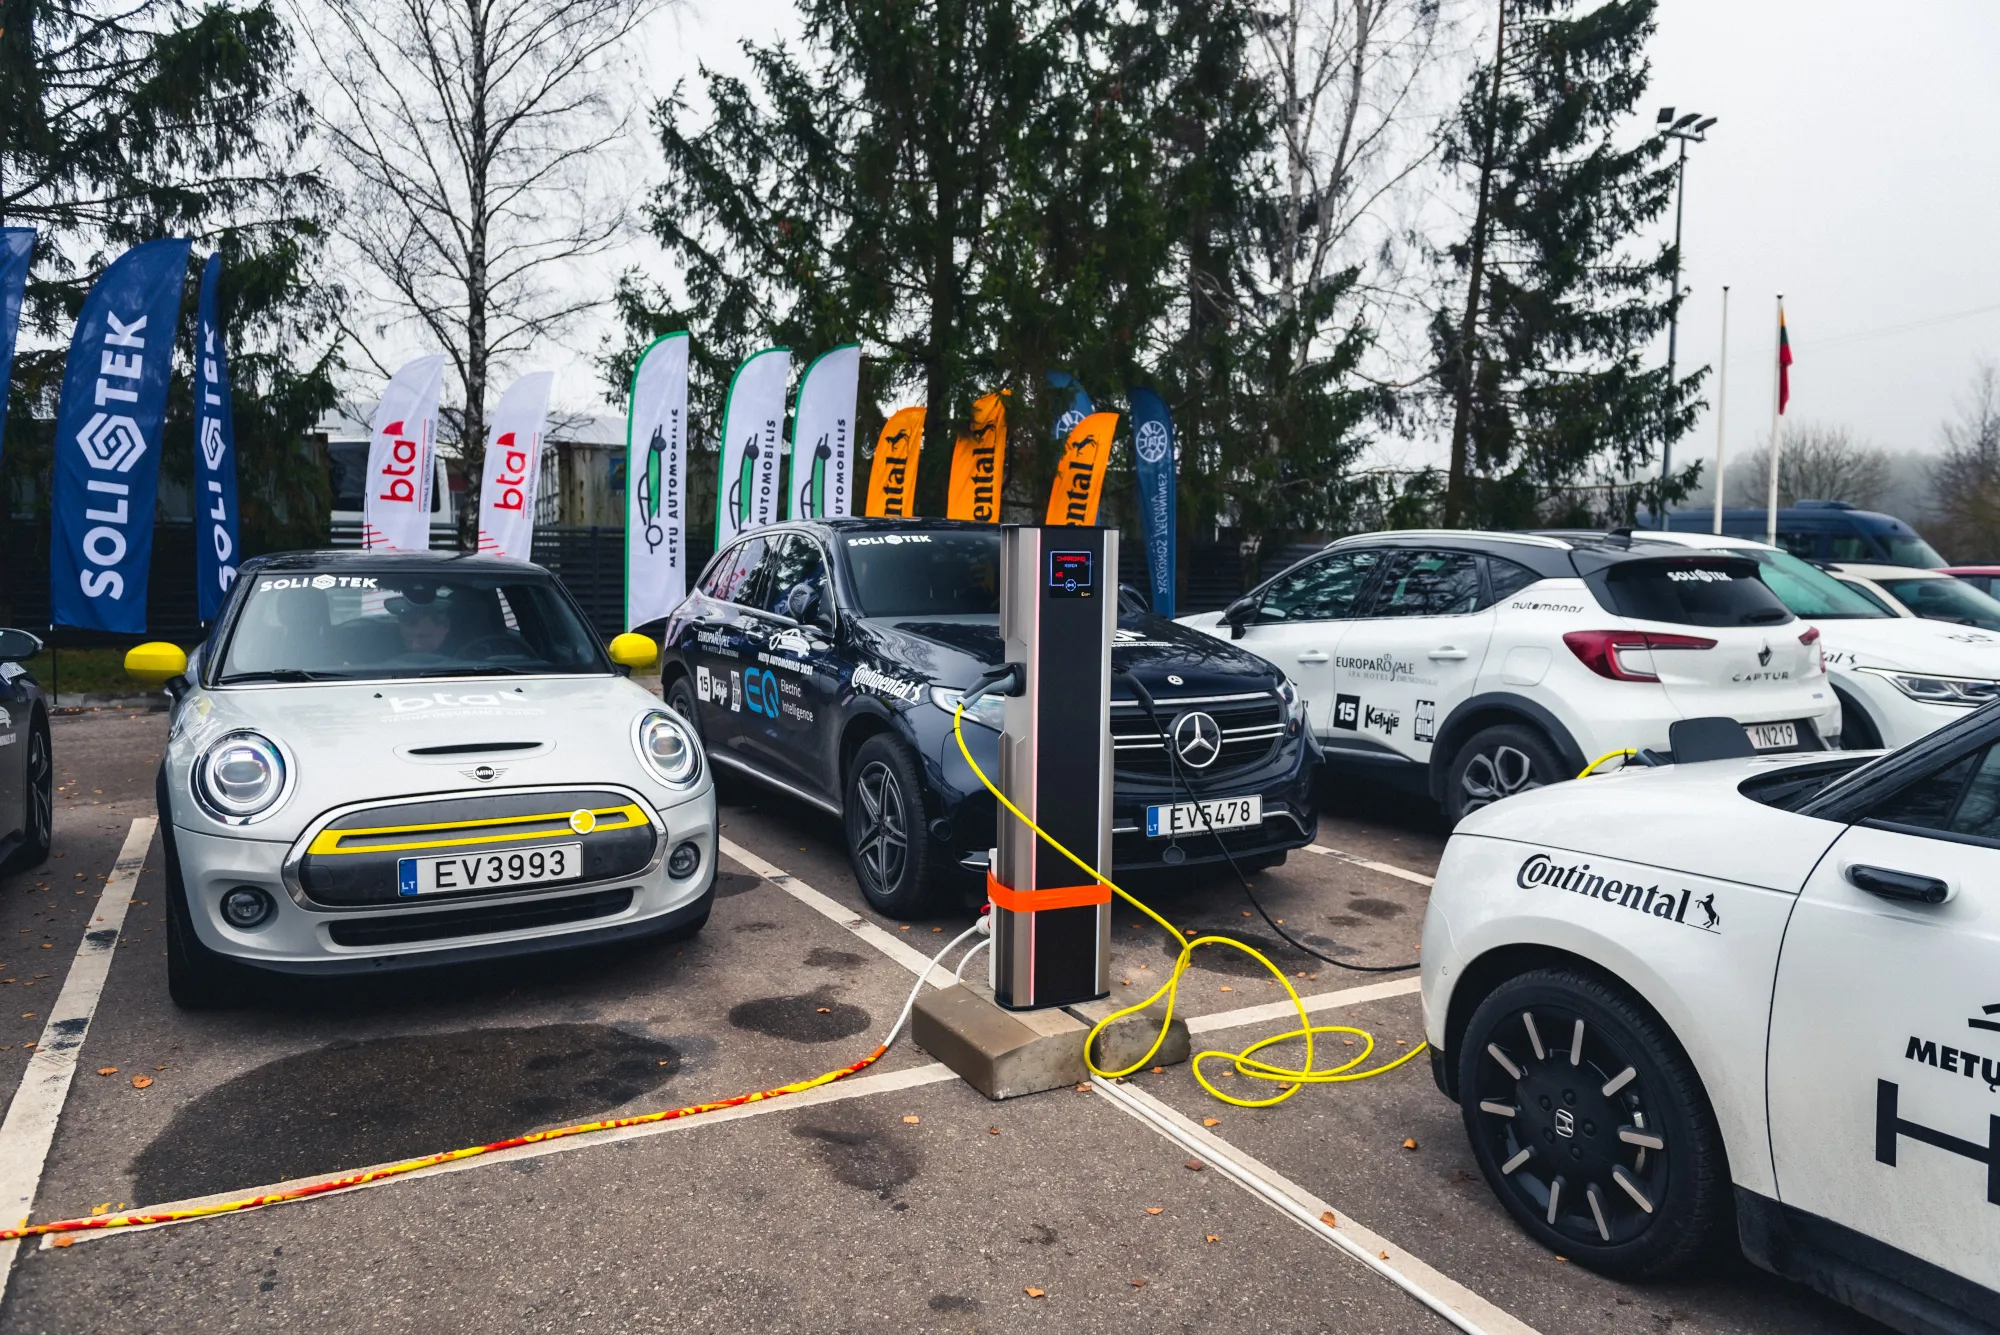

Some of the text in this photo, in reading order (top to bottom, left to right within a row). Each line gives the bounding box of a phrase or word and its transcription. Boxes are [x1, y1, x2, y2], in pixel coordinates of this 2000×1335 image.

[380, 440, 416, 502] bta
[494, 450, 527, 510] bta
[759, 419, 776, 525] AUTOMOBILIS
[835, 418, 846, 514] UTOMOBILIS
[700, 675, 709, 692] 15
[744, 666, 779, 718] EQ
[780, 678, 801, 698] Electric
[851, 663, 912, 702] Continental
[1732, 671, 1789, 682] CAPTUR
[782, 701, 814, 722] Intelligence
[1338, 702, 1357, 722] 15
[475, 769, 494, 777] MINI
[1148, 823, 1158, 832] LT
[1170, 800, 1250, 831] EV5478
[401, 849, 566, 890] LT EV3993
[1516, 853, 1692, 924] Continental
[1905, 1035, 2000, 1093] METŲ
